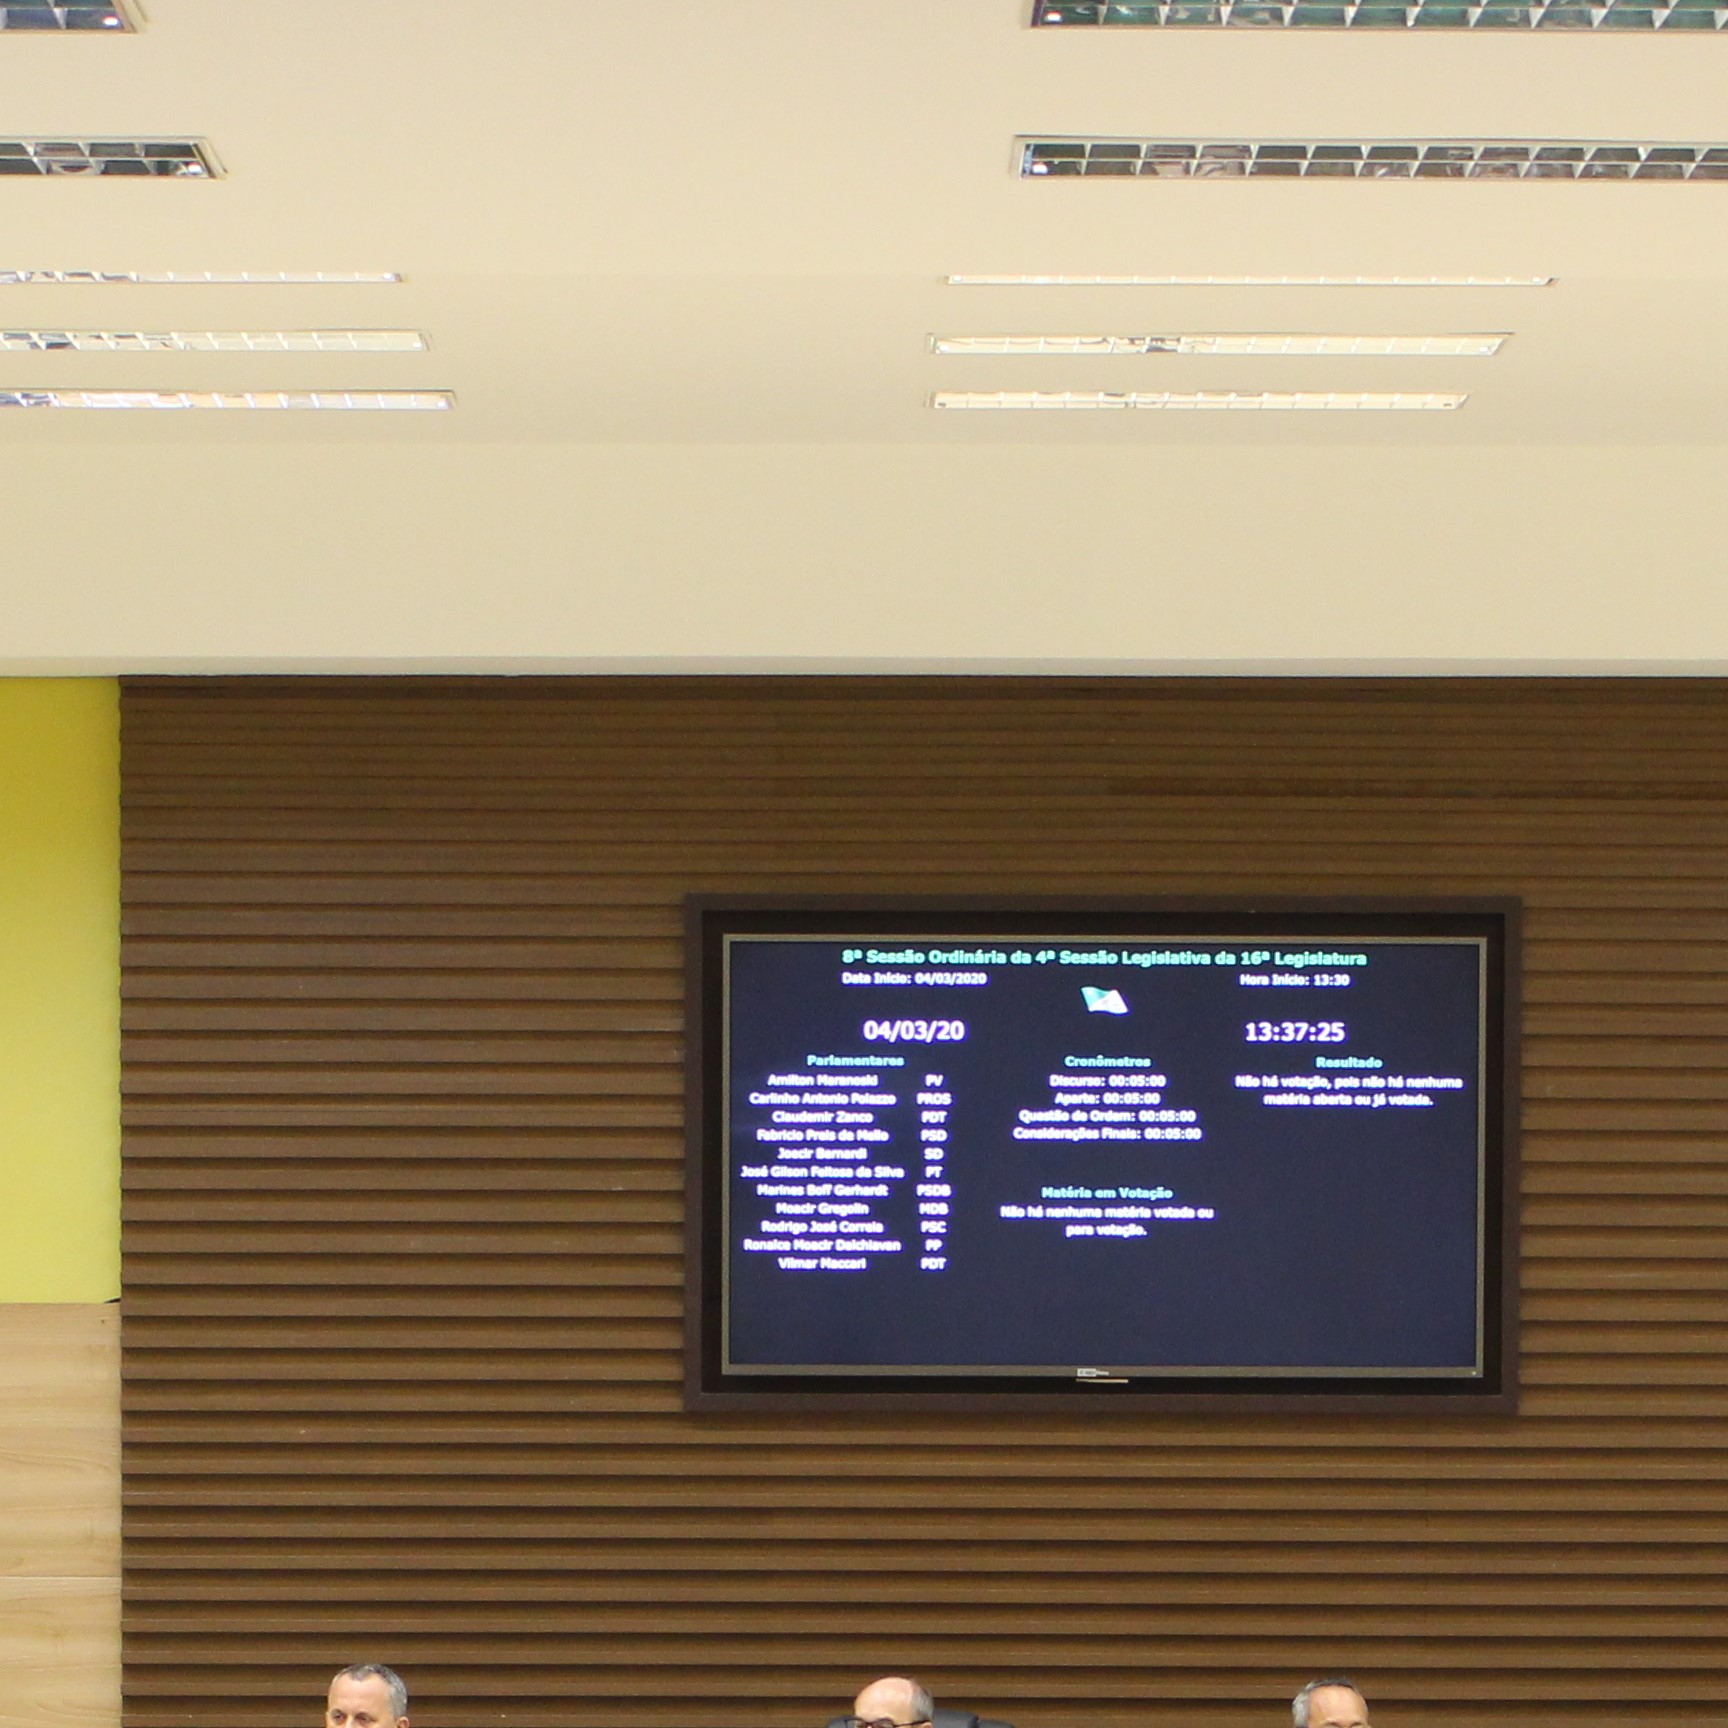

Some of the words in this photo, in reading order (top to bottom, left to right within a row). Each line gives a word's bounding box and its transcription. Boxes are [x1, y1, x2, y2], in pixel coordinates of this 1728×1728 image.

[842, 950, 862, 963] 8ª
[866, 949, 925, 963] Sessão
[928, 949, 1007, 964] Ordinária
[1010, 950, 1032, 964] da
[1035, 950, 1055, 964] 4ª
[1060, 950, 1118, 964] Sessão
[1122, 951, 1211, 967] Legislativa
[1215, 951, 1236, 964] da
[1241, 951, 1270, 965] 16ª
[1275, 951, 1367, 968] Legislatura
[842, 972, 871, 984] Data
[874, 972, 911, 984] Início:
[915, 972, 987, 985] 04/03/2020
[1240, 974, 1269, 985] Hora
[1272, 974, 1309, 985] Início:
[1314, 974, 1350, 986] 13:30
[864, 1020, 964, 1042] 04/03/20
[1246, 1022, 1345, 1042] 13:37:25
[807, 1055, 904, 1066] Parlamentares
[1065, 1055, 1151, 1067] Cronômetros
[1316, 1057, 1382, 1068] Resultado
[767, 1074, 815, 1086] Amilton
[926, 1074, 943, 1086] PV
[1050, 1075, 1105, 1086] Discurso:
[1109, 1075, 1166, 1087] 00:05:00
[1235, 1075, 1261, 1087] Não
[1262, 1075, 1279, 1087] há
[1280, 1075, 1332, 1090] votação,
[1334, 1076, 1360, 1089] pois
[1362, 1076, 1386, 1088] não
[1387, 1076, 1404, 1088] há
[1406, 1076, 1463, 1088] nenhuma
[801, 1093, 849, 1104] Antonio
[917, 1093, 952, 1105] PROS
[1055, 1092, 1099, 1106] Aparte:
[1103, 1092, 1160, 1104] 00:05:00
[1264, 1093, 1311, 1105] matéria
[1312, 1093, 1353, 1105] aberta
[1354, 1095, 1371, 1105] ou
[1372, 1093, 1387, 1107] já
[1388, 1094, 1433, 1105] votada.
[772, 1111, 834, 1122] Claudemir
[836, 1111, 873, 1123] Zanco
[921, 1111, 947, 1123] PDT
[1019, 1109, 1071, 1124] Questão
[1071, 1110, 1088, 1122] de
[1089, 1110, 1135, 1122] Ordem:
[1138, 1110, 1196, 1122] 00:05:00
[837, 1129, 855, 1141] de
[921, 1129, 947, 1141] PSD
[1013, 1127, 1100, 1141] Considerações
[1101, 1127, 1141, 1139] Finais:
[1144, 1128, 1202, 1140] 00:05:00
[815, 1147, 867, 1159] Bernardi
[924, 1148, 944, 1160] SD
[741, 1165, 769, 1177] José
[770, 1166, 808, 1177] Gilson
[810, 1166, 854, 1178] Feitosa
[854, 1166, 872, 1178] da
[874, 1166, 904, 1178] Silva
[926, 1166, 942, 1178] PT
[757, 1184, 805, 1196] Marines
[917, 1184, 951, 1196] PSDB
[1042, 1186, 1092, 1198] Matéria
[1095, 1190, 1116, 1198] em
[1119, 1187, 1173, 1200] Votação
[776, 1203, 817, 1214] Moacir
[817, 1202, 869, 1216] Gregolin
[919, 1203, 948, 1214] MDB
[1000, 1205, 1026, 1217] Não
[1027, 1205, 1044, 1218] há
[1045, 1206, 1103, 1218] nenhuma
[1104, 1206, 1152, 1218] matéria
[1153, 1206, 1196, 1218] votada
[1196, 1208, 1214, 1218] ou
[761, 1221, 808, 1234] Rodrigo
[809, 1221, 838, 1232] José
[921, 1221, 946, 1233] PSC
[1066, 1225, 1094, 1237] para
[1096, 1223, 1147, 1238] votação.
[926, 1239, 942, 1251] PP
[778, 1257, 819, 1269] Vilmar
[921, 1258, 946, 1269] PDT
